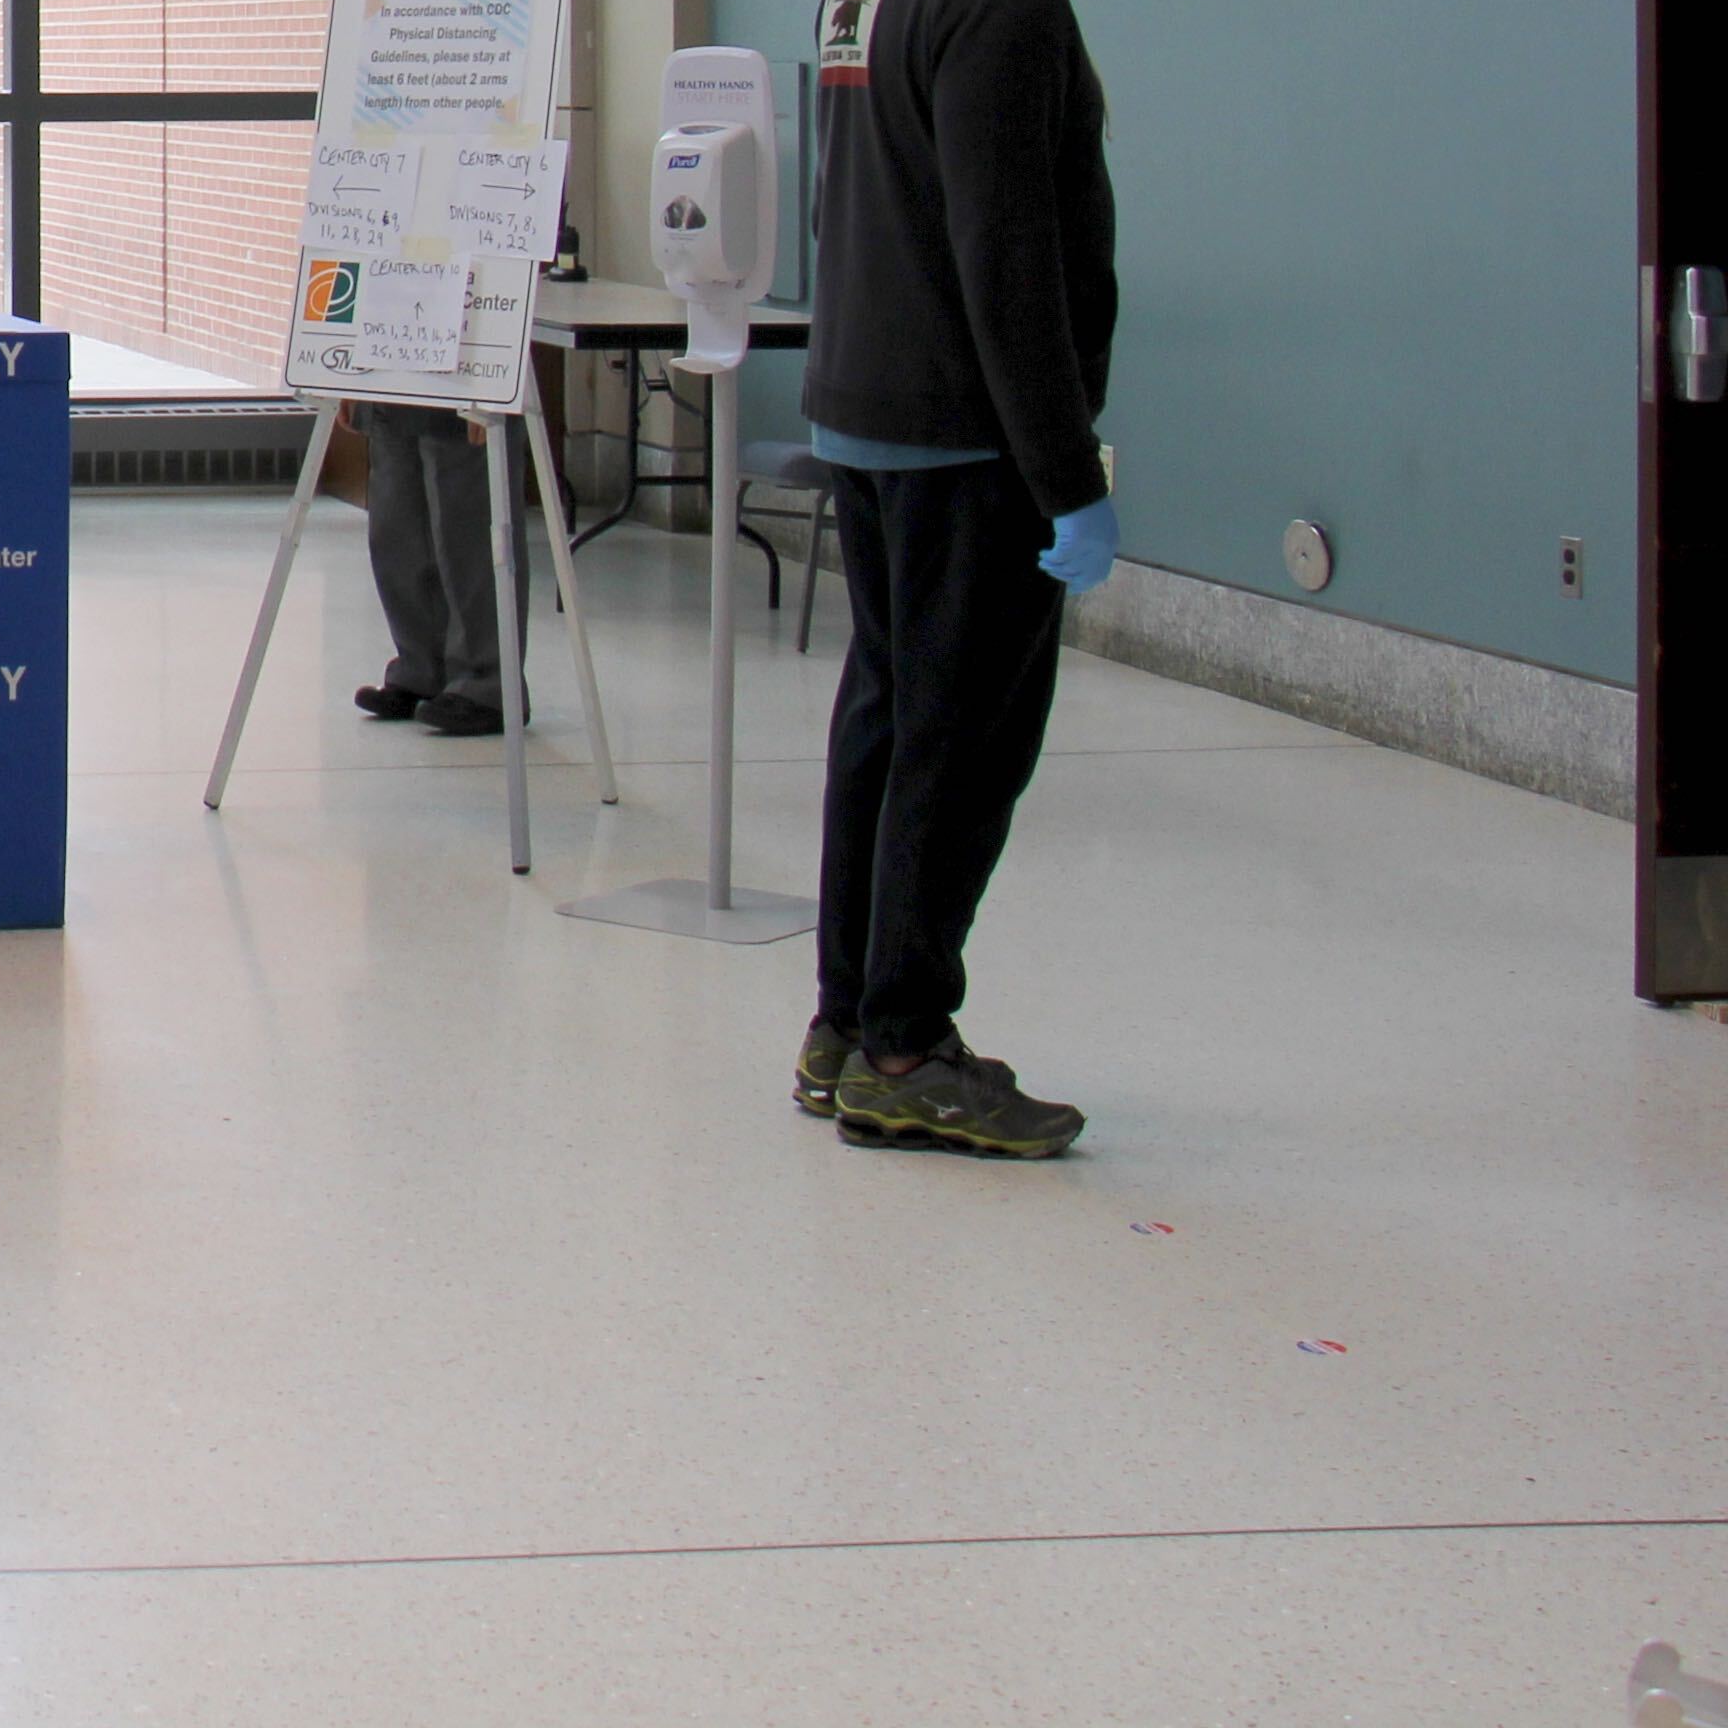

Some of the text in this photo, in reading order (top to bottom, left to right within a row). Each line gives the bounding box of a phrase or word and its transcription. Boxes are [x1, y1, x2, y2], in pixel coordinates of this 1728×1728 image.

[380, 3, 512, 17] In accordance with CDC
[389, 27, 497, 42] Physical Distancing
[371, 50, 511, 64] Guidelines, please stay at
[367, 73, 508, 88] least 6 feet (about 2 arms
[674, 80, 754, 89] HEALTHY HANDS
[364, 96, 505, 111] length) from other people.
[678, 92, 752, 104] START HERE
[318, 145, 406, 174] CENTER CITY 7
[458, 149, 548, 176] CENTER CITY 6
[308, 201, 363, 220] DIVISIONS
[449, 205, 503, 225] DIVISIONS
[506, 233, 528, 253] 22
[369, 258, 420, 277] CENTER
[423, 263, 445, 280] CITY
[463, 291, 518, 312] Center
[298, 350, 316, 364] AN
[457, 361, 510, 379] FACILITY
